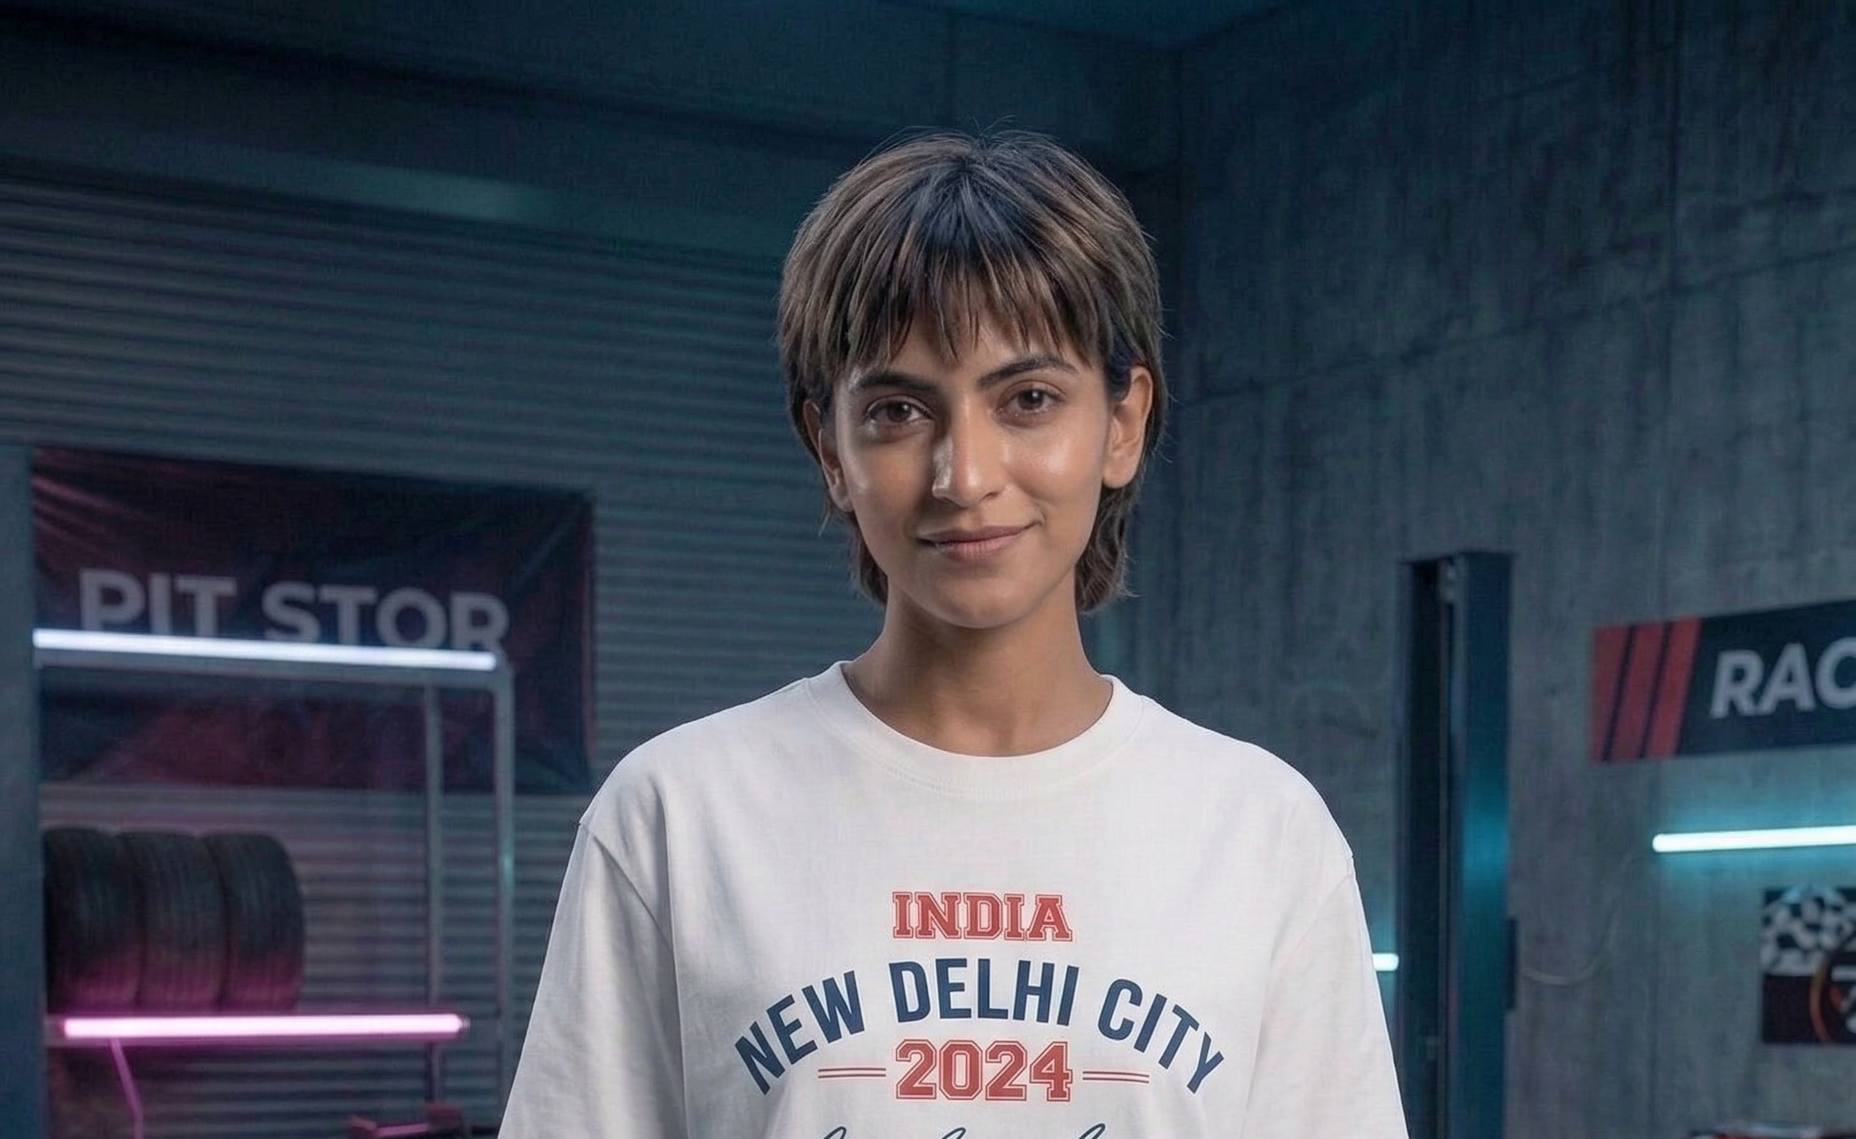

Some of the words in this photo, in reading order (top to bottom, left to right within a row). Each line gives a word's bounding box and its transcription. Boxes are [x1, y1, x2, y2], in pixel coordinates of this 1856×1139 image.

[78, 568, 237, 638] PIT
[892, 891, 1073, 942] INDIA
[734, 970, 865, 1095] NEW
[888, 957, 1080, 1027] DELHI
[1097, 978, 1225, 1094] CITY
[895, 1039, 1074, 1102] 2024
